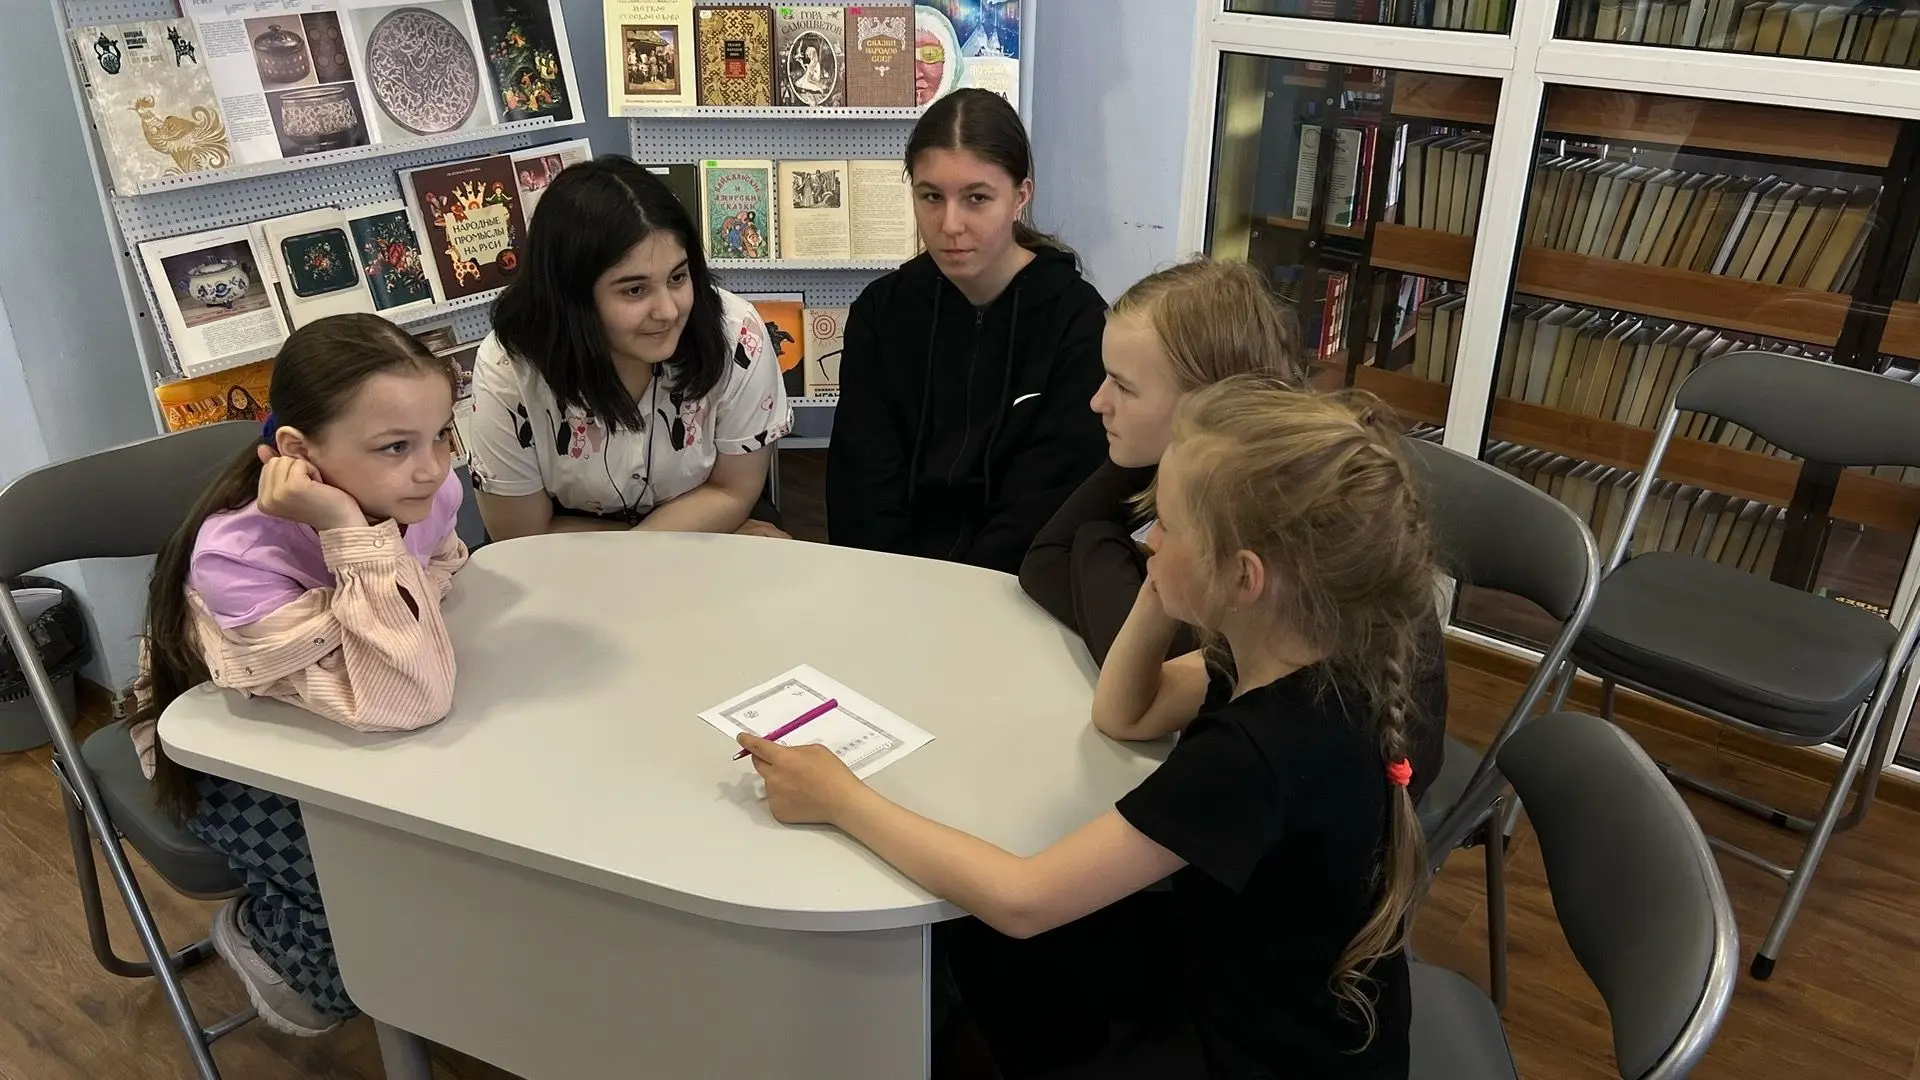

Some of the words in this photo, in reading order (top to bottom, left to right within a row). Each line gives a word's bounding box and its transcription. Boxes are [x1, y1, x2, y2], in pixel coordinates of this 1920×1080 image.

[800, 11, 823, 20] ГОРА
[781, 20, 842, 35] САМОЦВЕТОВ
[452, 216, 501, 234] НАРОДНЫЕ
[454, 227, 505, 246] ПРОМЫСЛЫ
[463, 246, 478, 256] НА
[478, 240, 502, 252] РУСИ
